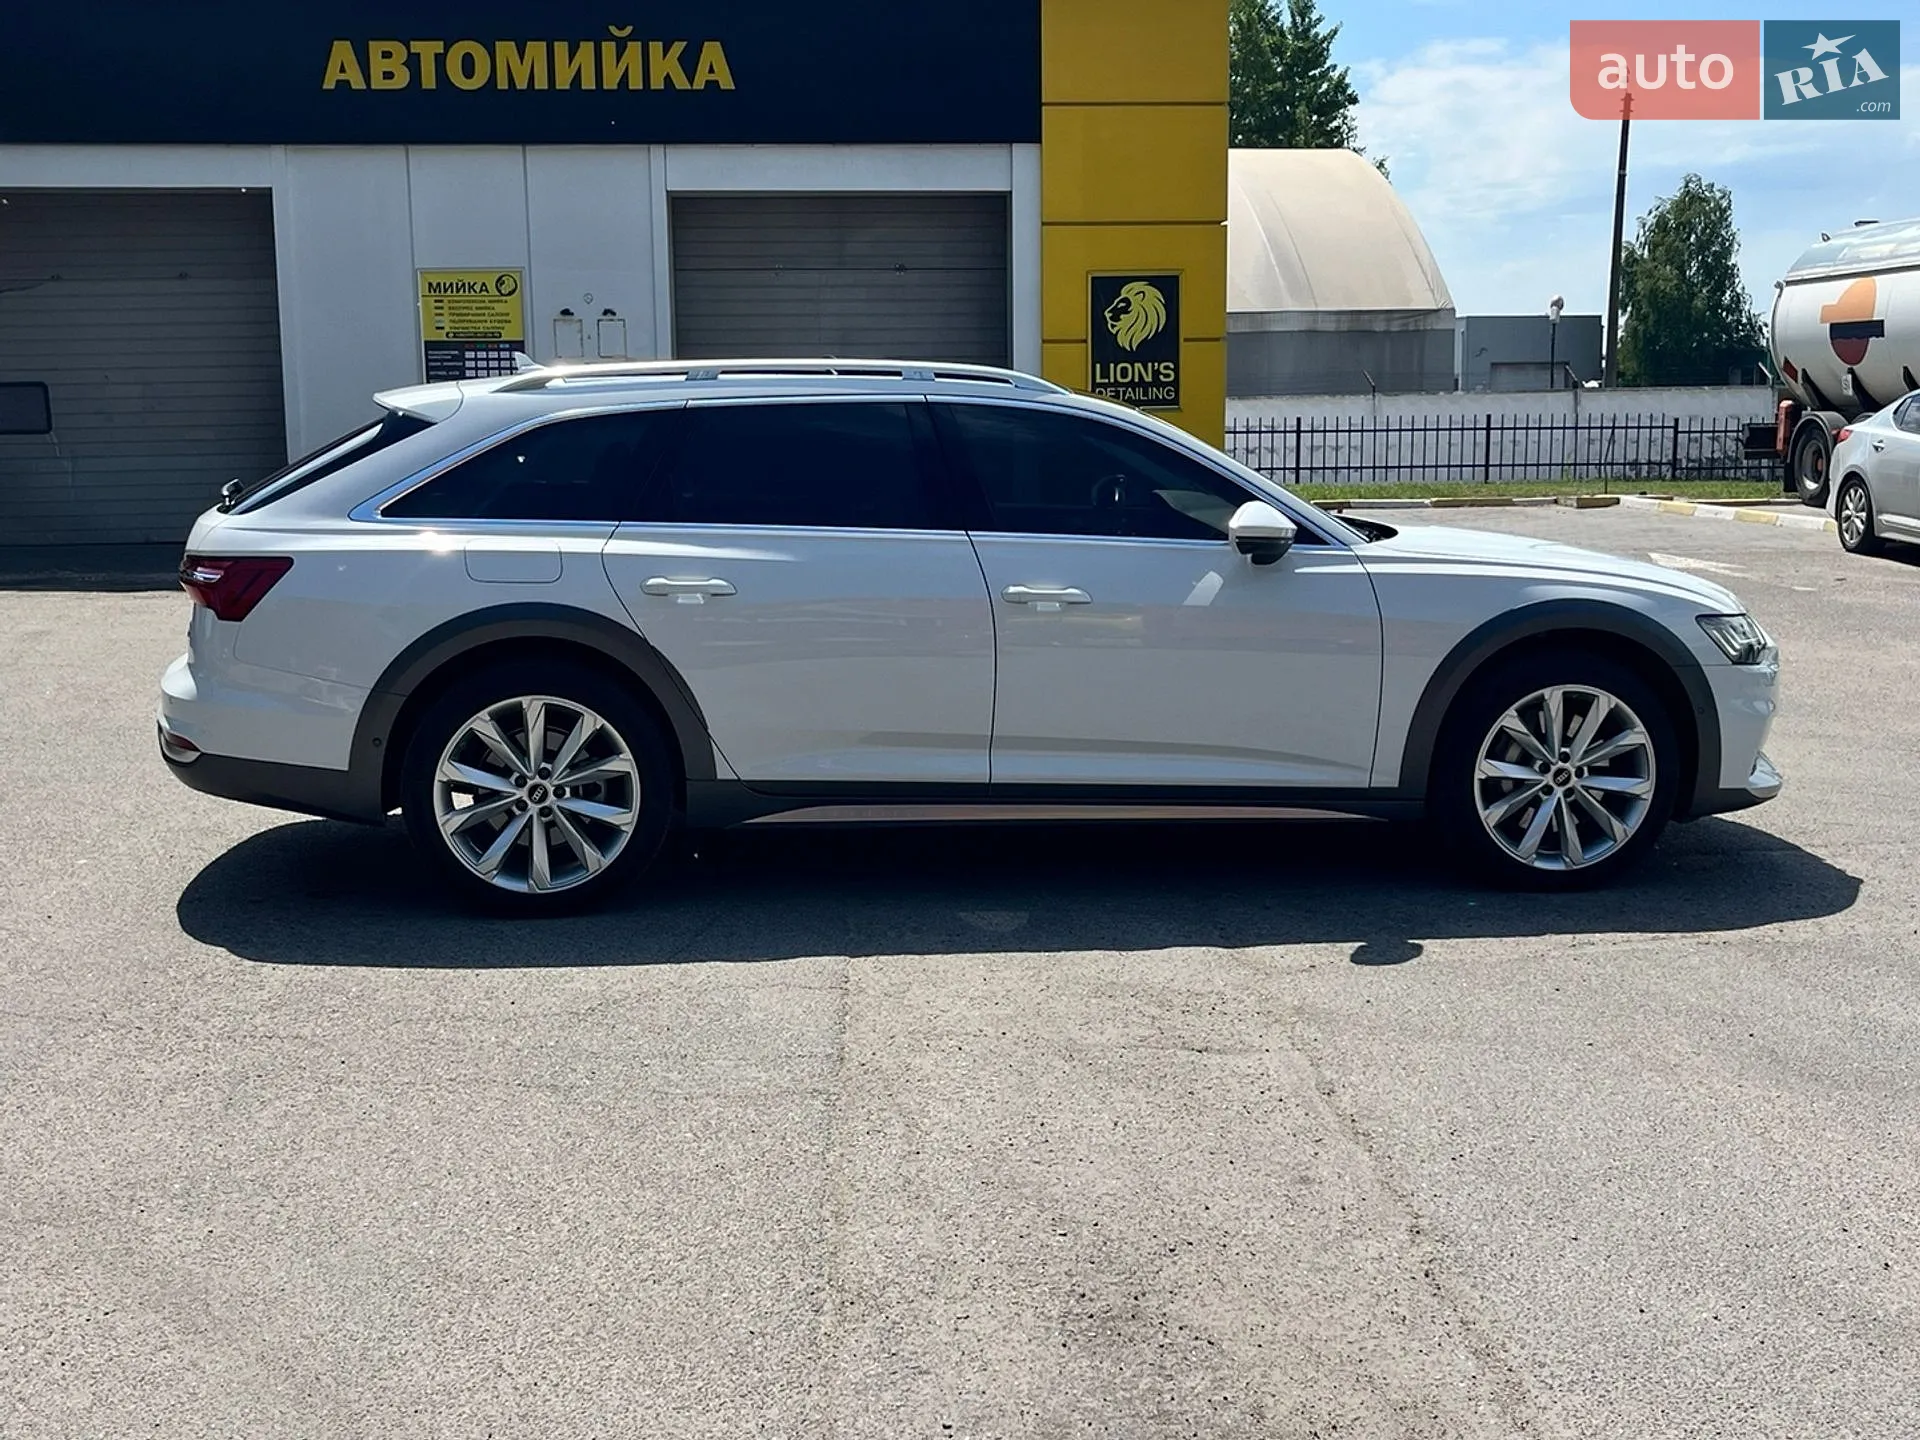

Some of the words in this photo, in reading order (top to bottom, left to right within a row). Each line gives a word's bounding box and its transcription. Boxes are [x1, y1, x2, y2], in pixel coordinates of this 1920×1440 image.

[322, 25, 736, 91] АВТОМИЙКА
[427, 279, 490, 294] МИЙКА
[1095, 362, 1175, 383] LION'S
[1095, 386, 1176, 400] DETAILING
